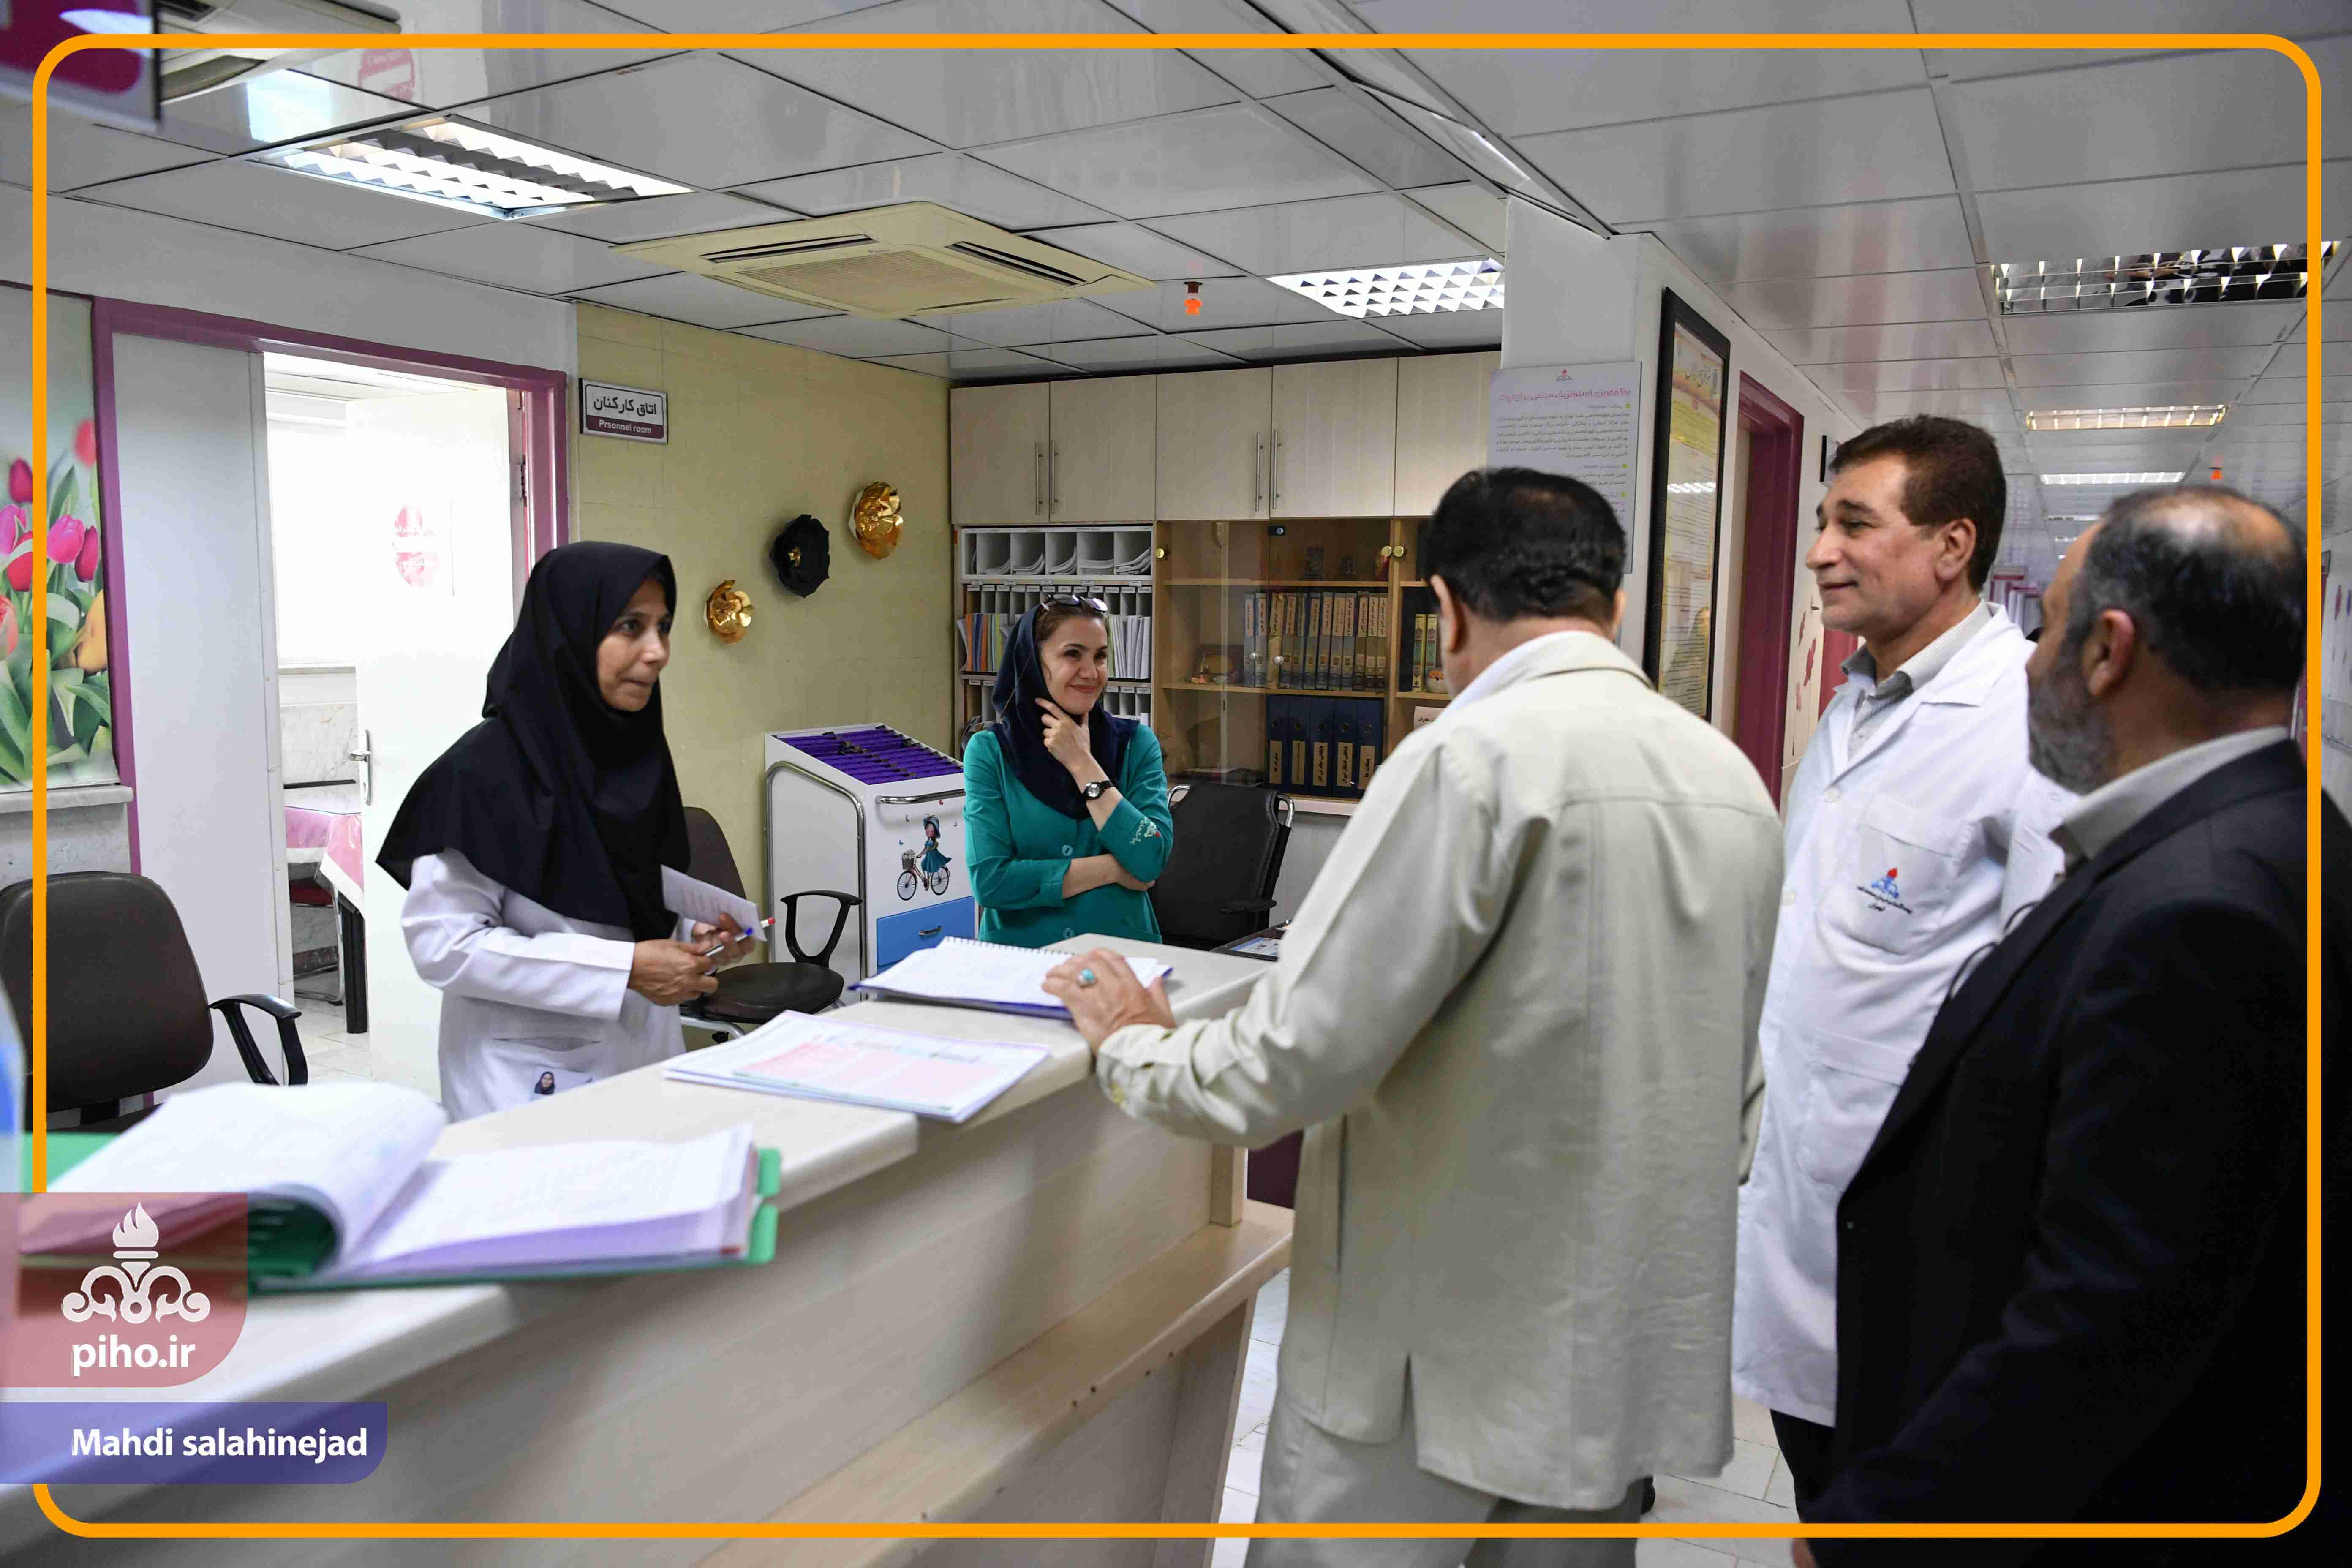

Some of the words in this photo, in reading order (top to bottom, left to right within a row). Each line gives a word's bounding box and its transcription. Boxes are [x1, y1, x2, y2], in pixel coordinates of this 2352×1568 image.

[593, 396, 634, 414] کارکنان
[637, 403, 657, 416] اتاق
[599, 419, 632, 431] Prsonnel
